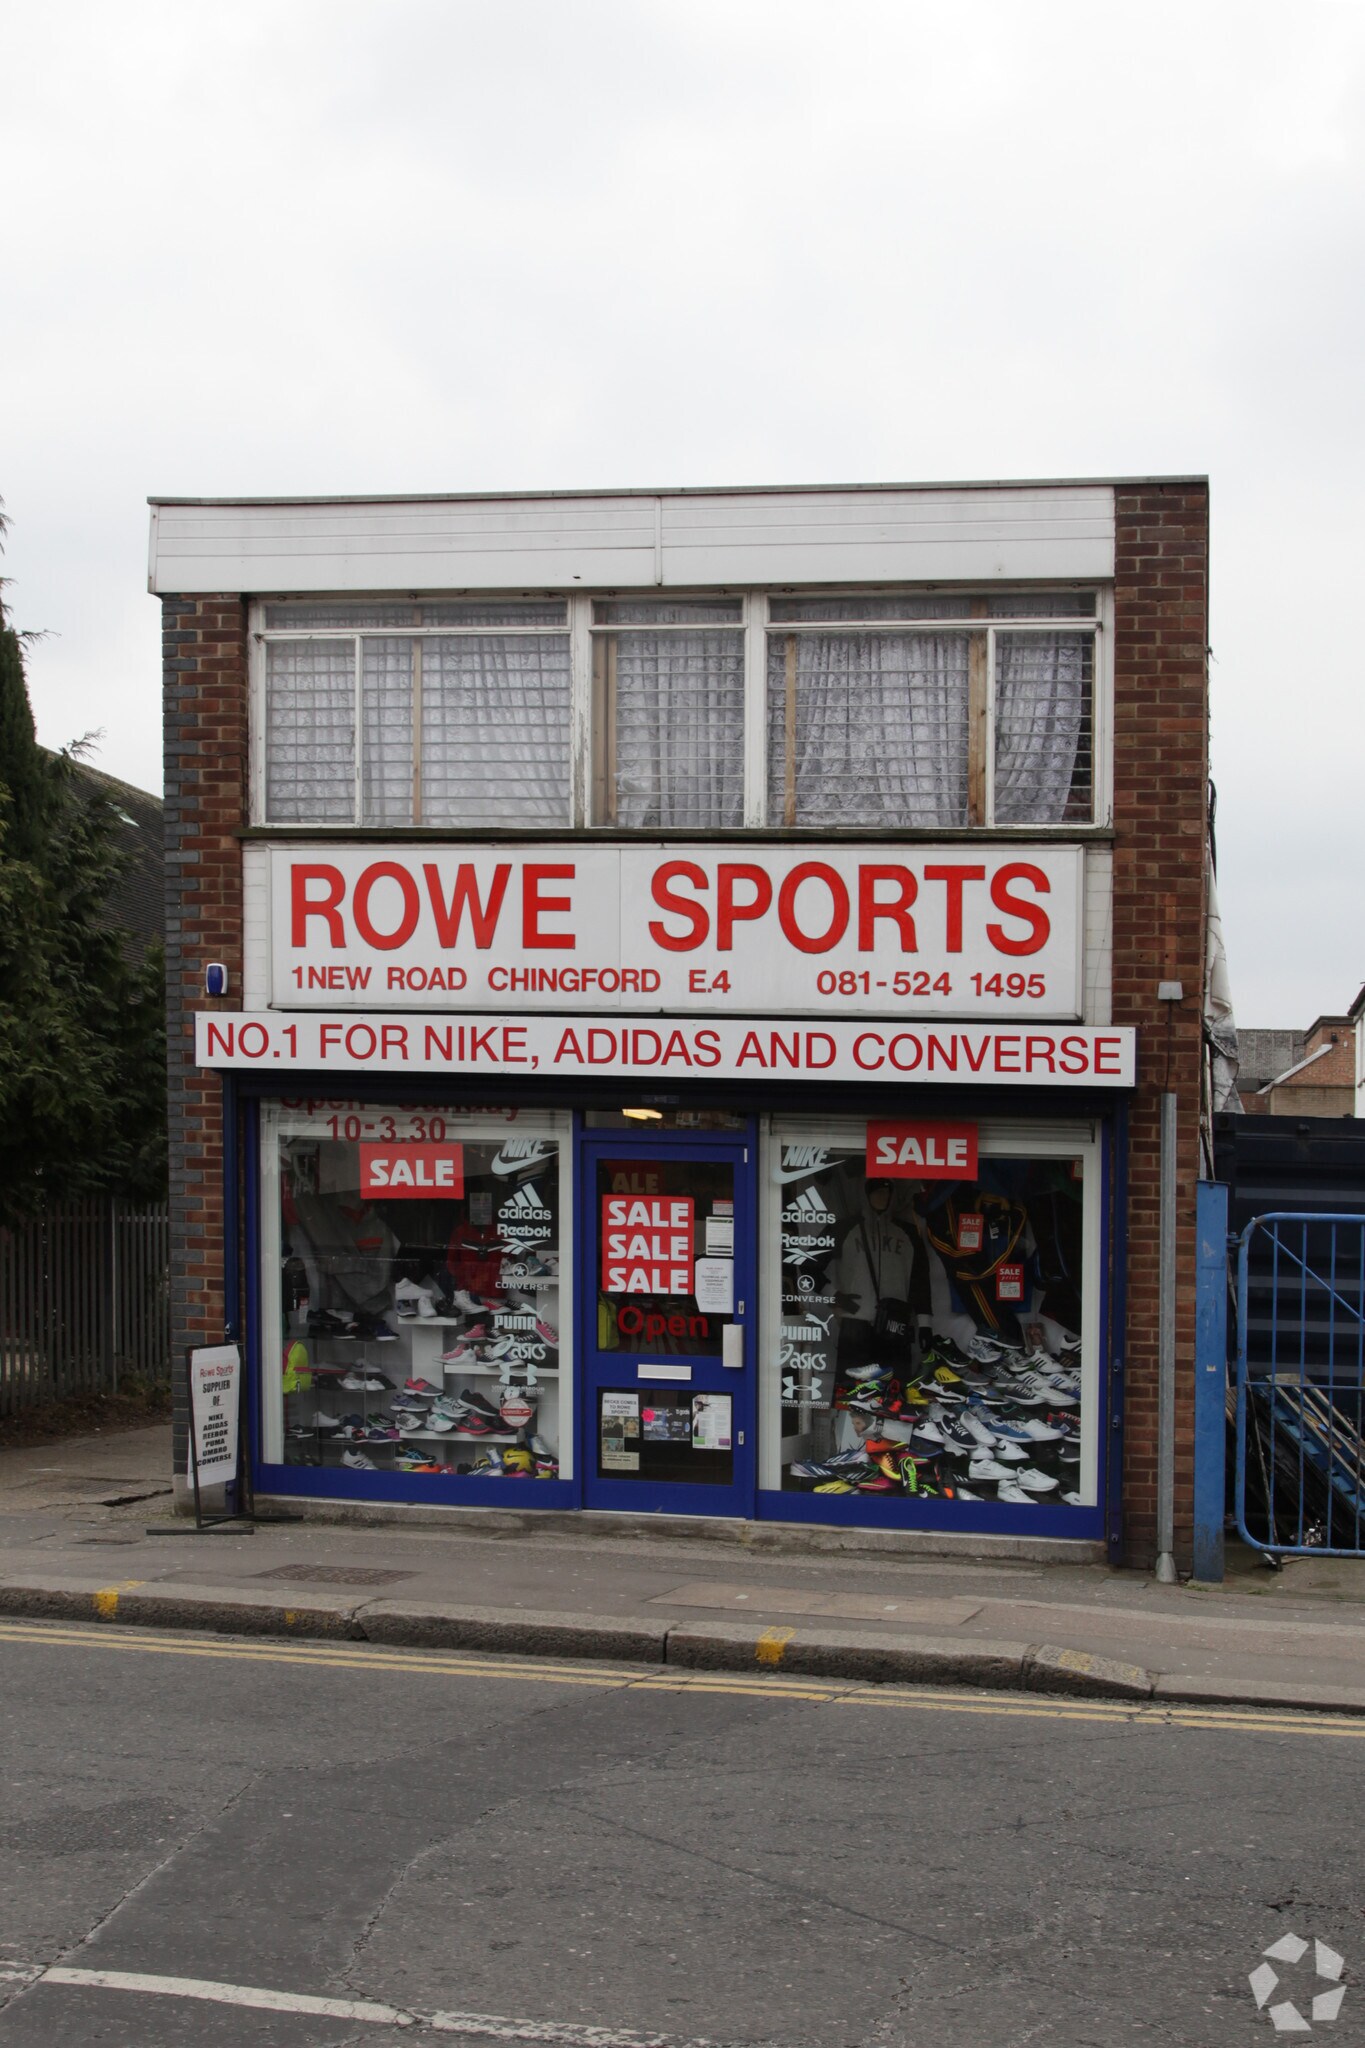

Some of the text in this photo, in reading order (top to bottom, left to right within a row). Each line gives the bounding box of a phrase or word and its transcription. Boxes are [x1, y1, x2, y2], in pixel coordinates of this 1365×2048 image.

[291, 861, 1050, 956] ROWE SPORTS
[388, 967, 467, 990] ROAD
[488, 967, 660, 992] CHINGFORD
[689, 969, 731, 992] E.4
[817, 970, 1046, 997] 081-524 1495
[207, 1022, 1121, 1075] NO.1 FOR NIKE, ADIDAS AND CONVERSE
[327, 1115, 447, 1143] 10-3.30
[501, 1137, 545, 1158] NIKE
[876, 1136, 967, 1167] SALE
[782, 1145, 831, 1167] NIKE
[369, 1159, 454, 1187] SALE
[611, 1172, 659, 1195] ALE
[497, 1207, 553, 1221] adidas
[608, 1200, 689, 1228] SALE
[781, 1209, 837, 1224] adidas
[961, 1218, 981, 1226] SALE
[496, 1223, 552, 1238] Reebok
[608, 1233, 689, 1261] SALE
[780, 1233, 836, 1248] Reebok
[999, 1268, 1020, 1276] SALE
[494, 1281, 550, 1292] CONVERSE
[608, 1267, 689, 1295] SALE
[494, 1314, 536, 1330] PUMA
[617, 1305, 709, 1342] Open
[886, 1319, 906, 1336] NIKE
[779, 1326, 822, 1341] PUMA
[203, 1380, 231, 1393] SUPPLIER
[213, 1396, 221, 1405] OF
[208, 1412, 224, 1421] NIKE
[203, 1421, 229, 1431] ADIDAS
[202, 1429, 228, 1440] REEBOK
[205, 1438, 225, 1448] PUMA
[203, 1446, 228, 1457] UMBRO
[197, 1453, 232, 1467] CONVERSE
